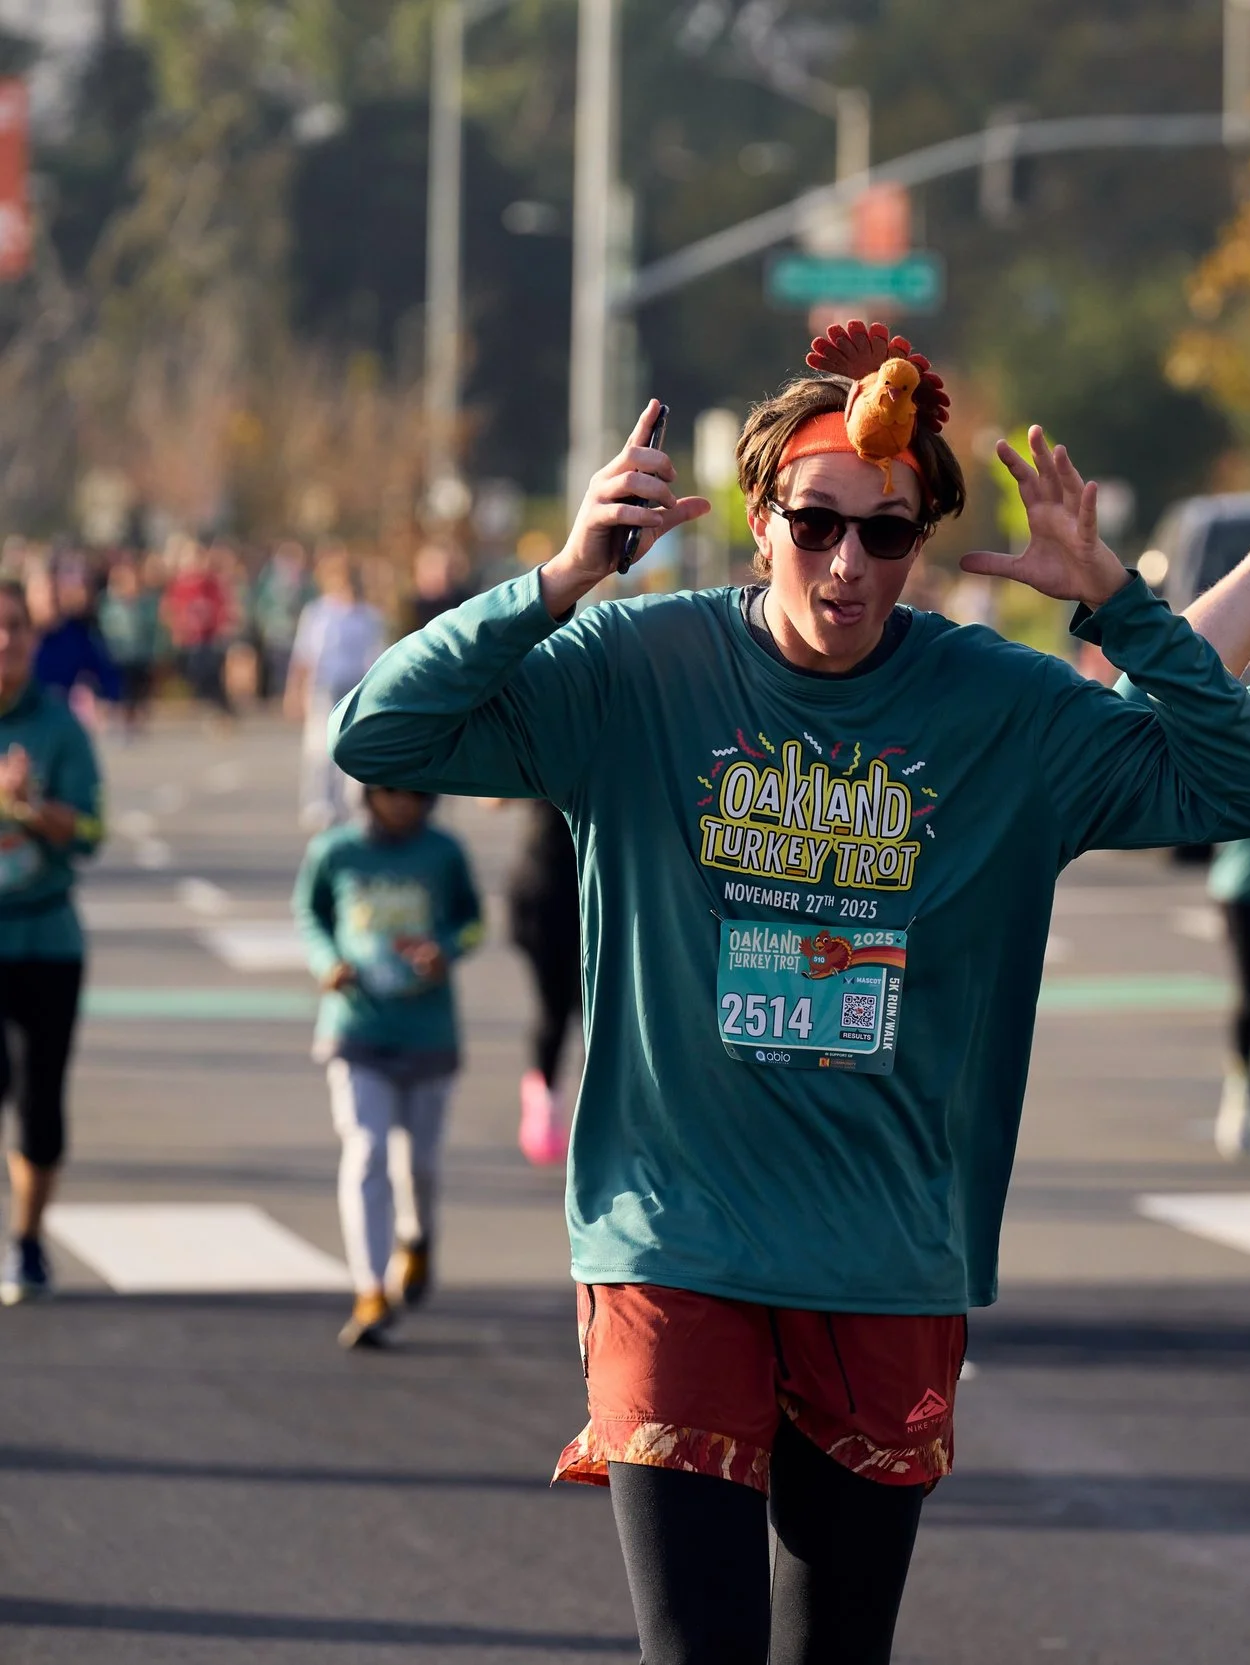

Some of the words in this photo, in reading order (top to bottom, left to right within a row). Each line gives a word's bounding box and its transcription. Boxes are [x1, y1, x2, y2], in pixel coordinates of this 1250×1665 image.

[721, 742, 910, 841] OAKLAND
[702, 819, 829, 879] TURKEY
[836, 841, 918, 886] TROT
[724, 881, 799, 911] NOVEMBER
[805, 894, 835, 914] 27TH
[840, 898, 877, 919] 2025
[729, 927, 801, 955] OAKLAND
[853, 932, 895, 947] 2025
[728, 952, 771, 972] TURKEY
[774, 955, 801, 973] TROT
[856, 976, 882, 985] MASCOT
[888, 977, 900, 991] 5K
[720, 992, 814, 1040] 2514
[882, 995, 899, 1051] RUN/WALK
[842, 1032, 872, 1041] RESULTS
[766, 1050, 791, 1063] abio
[907, 1422, 928, 1433] NIKE
